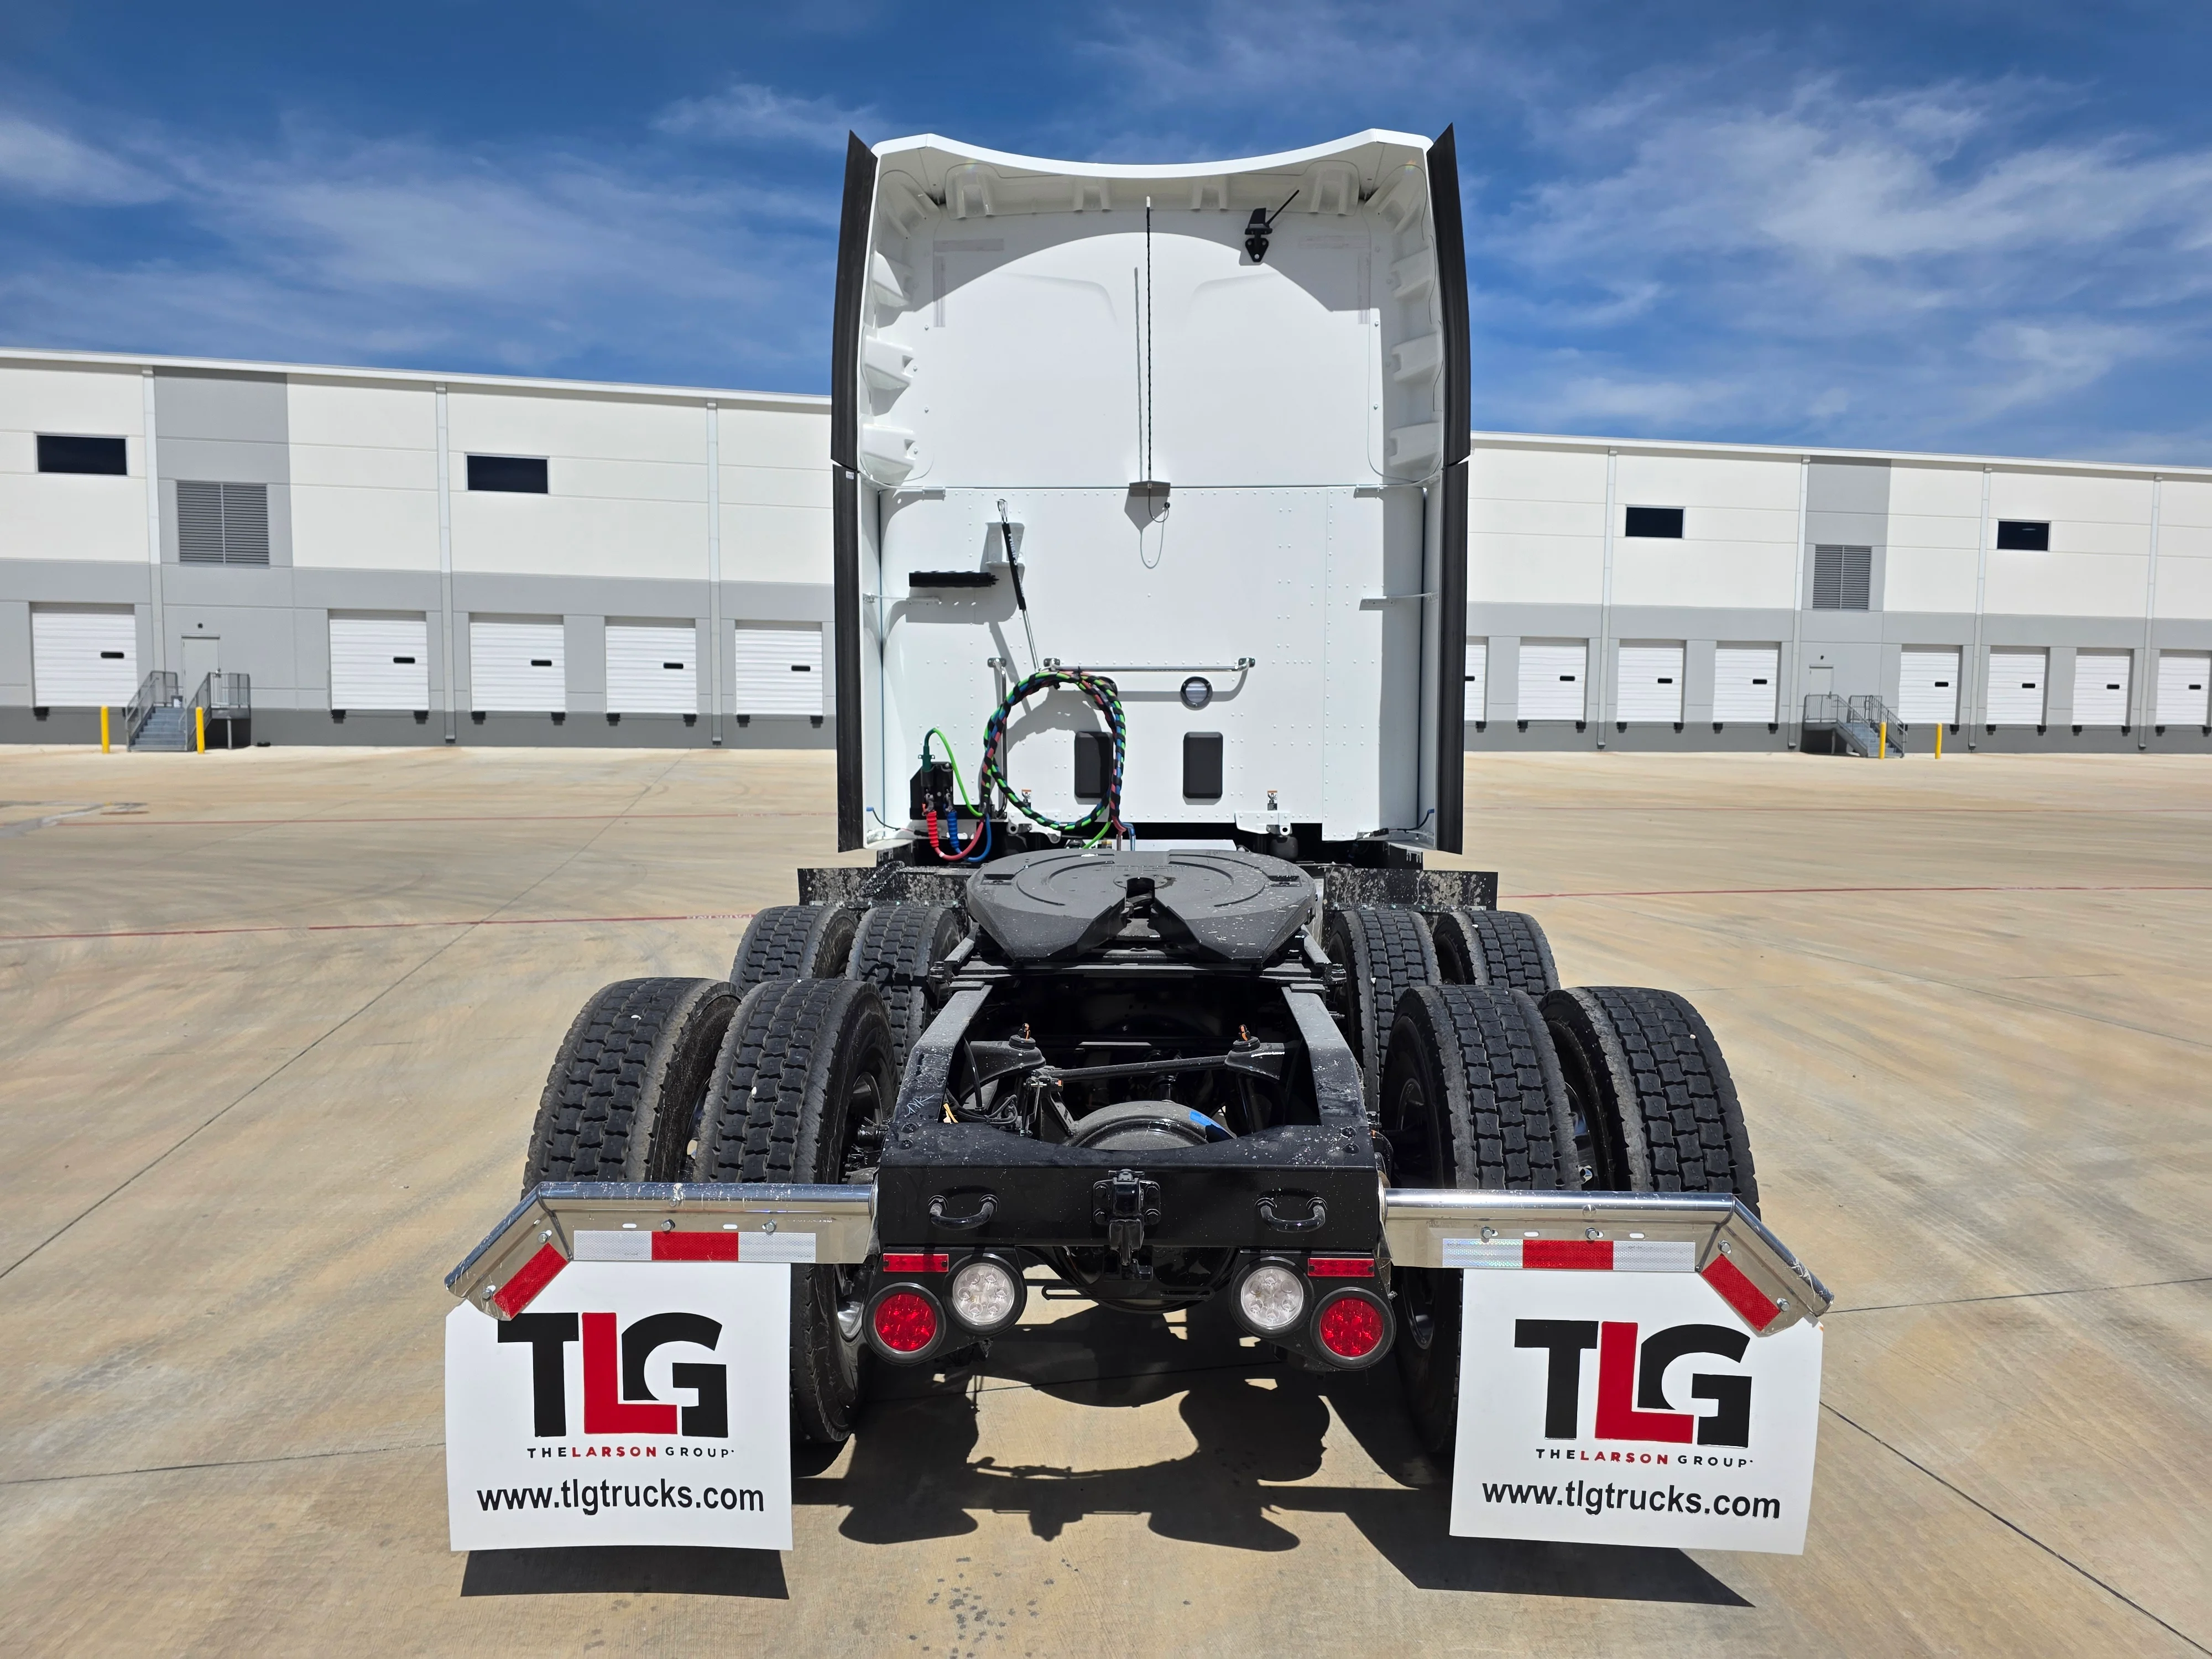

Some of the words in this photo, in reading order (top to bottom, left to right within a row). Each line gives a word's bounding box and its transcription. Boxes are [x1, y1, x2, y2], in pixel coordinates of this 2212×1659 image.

[497, 1312, 729, 1438] TLG
[1514, 1319, 1752, 1449] TLG
[665, 1447, 729, 1458] GROUP
[1677, 1455, 1747, 1468] GROUP
[476, 1478, 765, 1516] www.tlgtrucks.com
[1482, 1479, 1781, 1520] www.tlgtrucks.com
